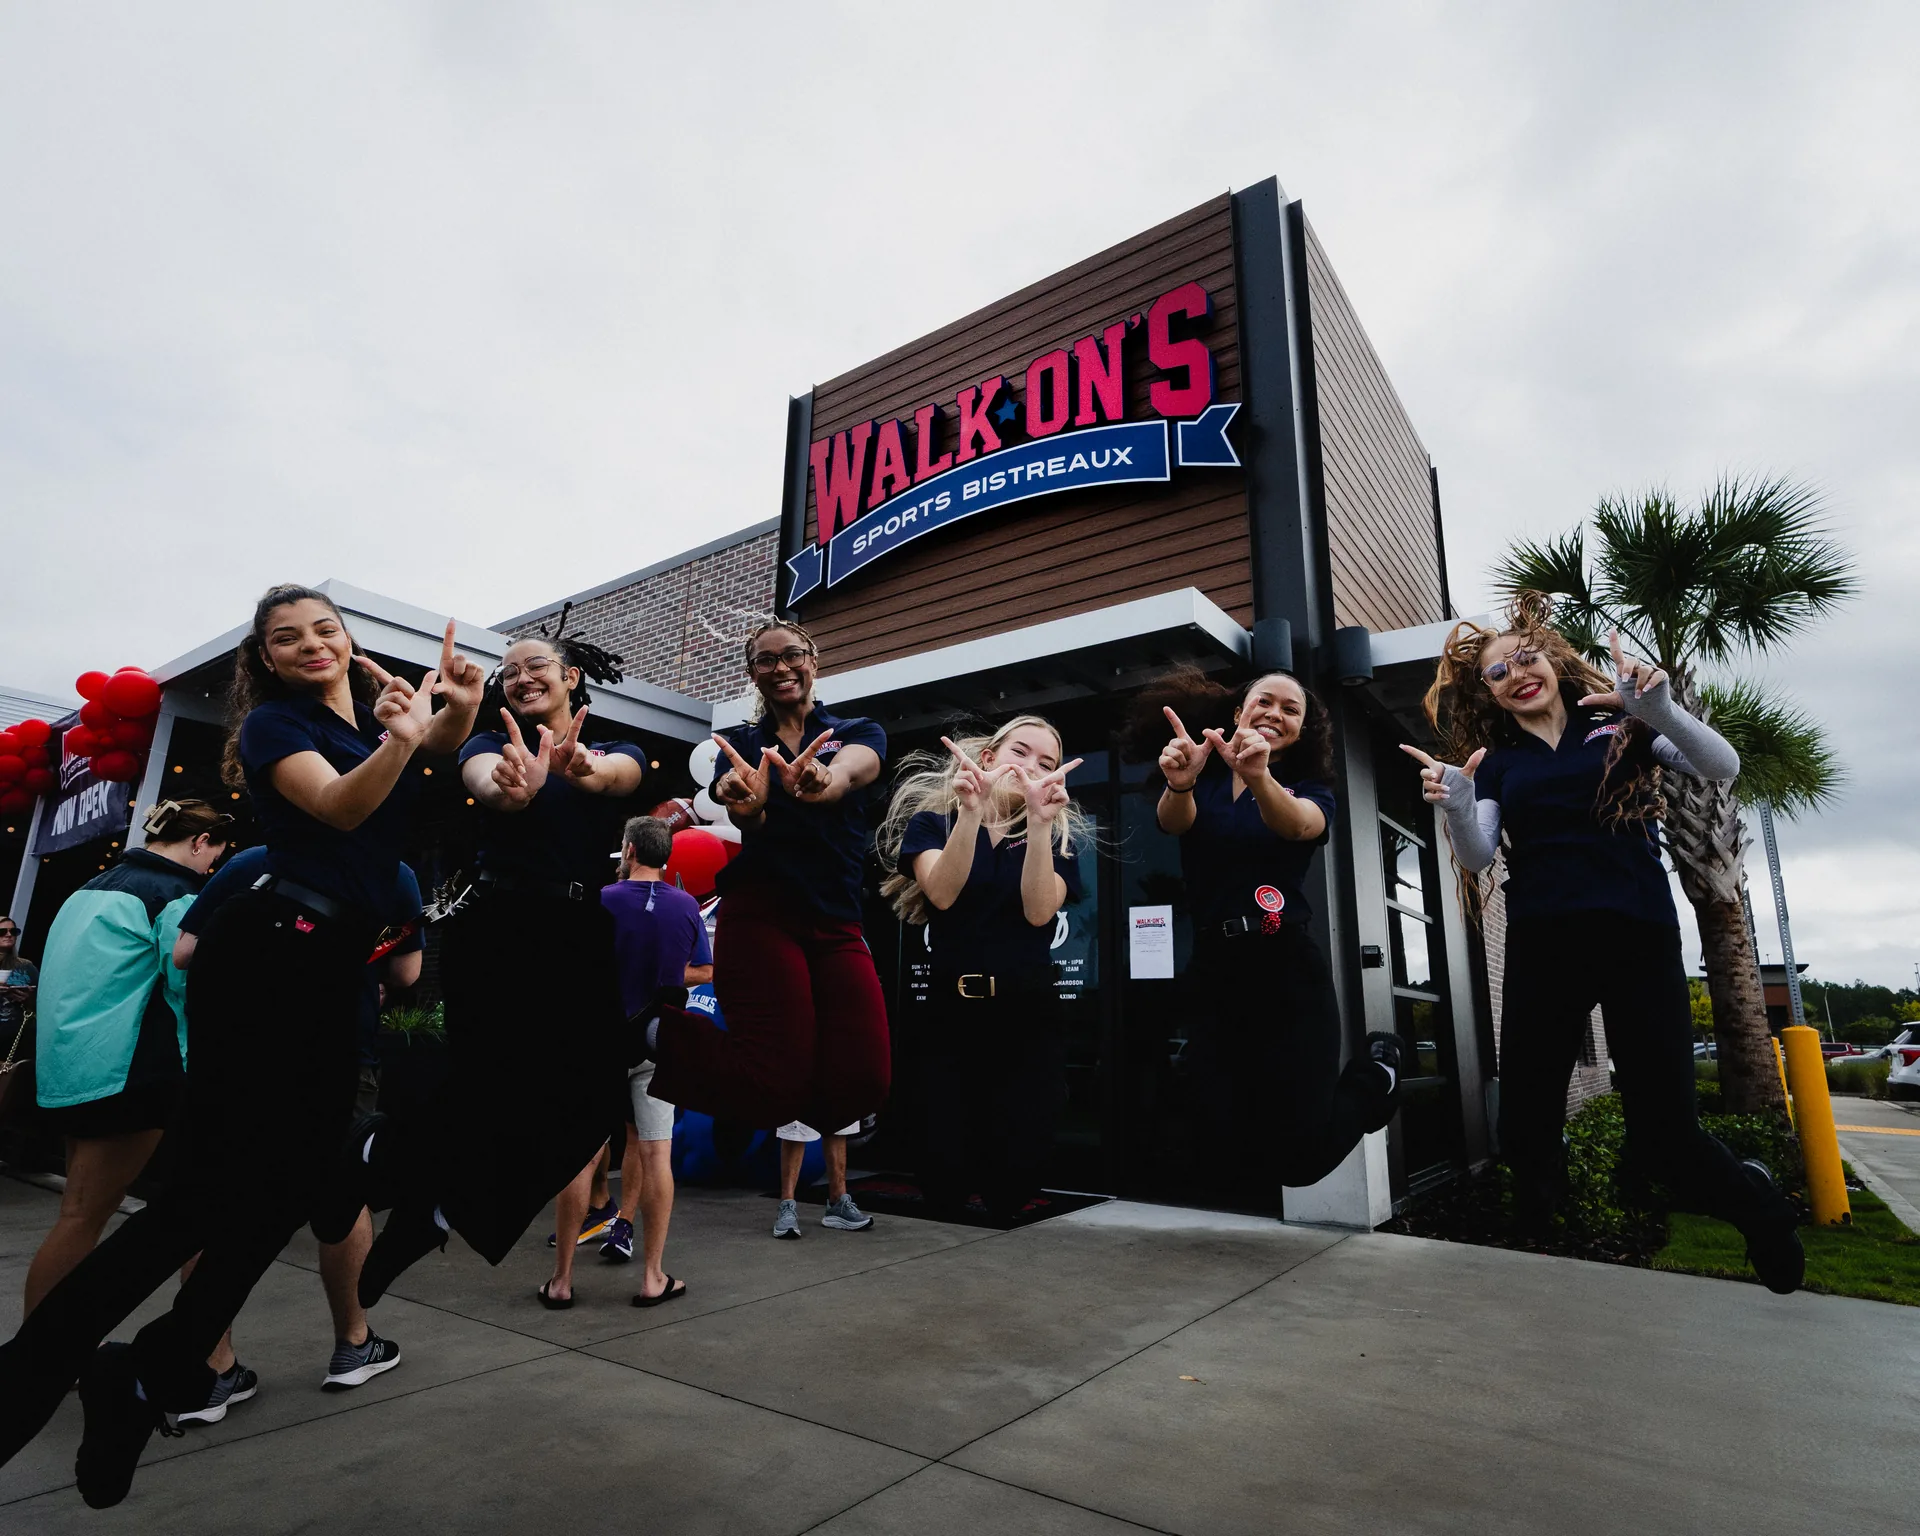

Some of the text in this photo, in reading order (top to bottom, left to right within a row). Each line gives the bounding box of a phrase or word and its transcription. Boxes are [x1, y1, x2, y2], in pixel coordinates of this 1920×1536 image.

[852, 446, 1134, 556] SPORTS BISTREAUX
[51, 780, 113, 836] NOW OPEN
